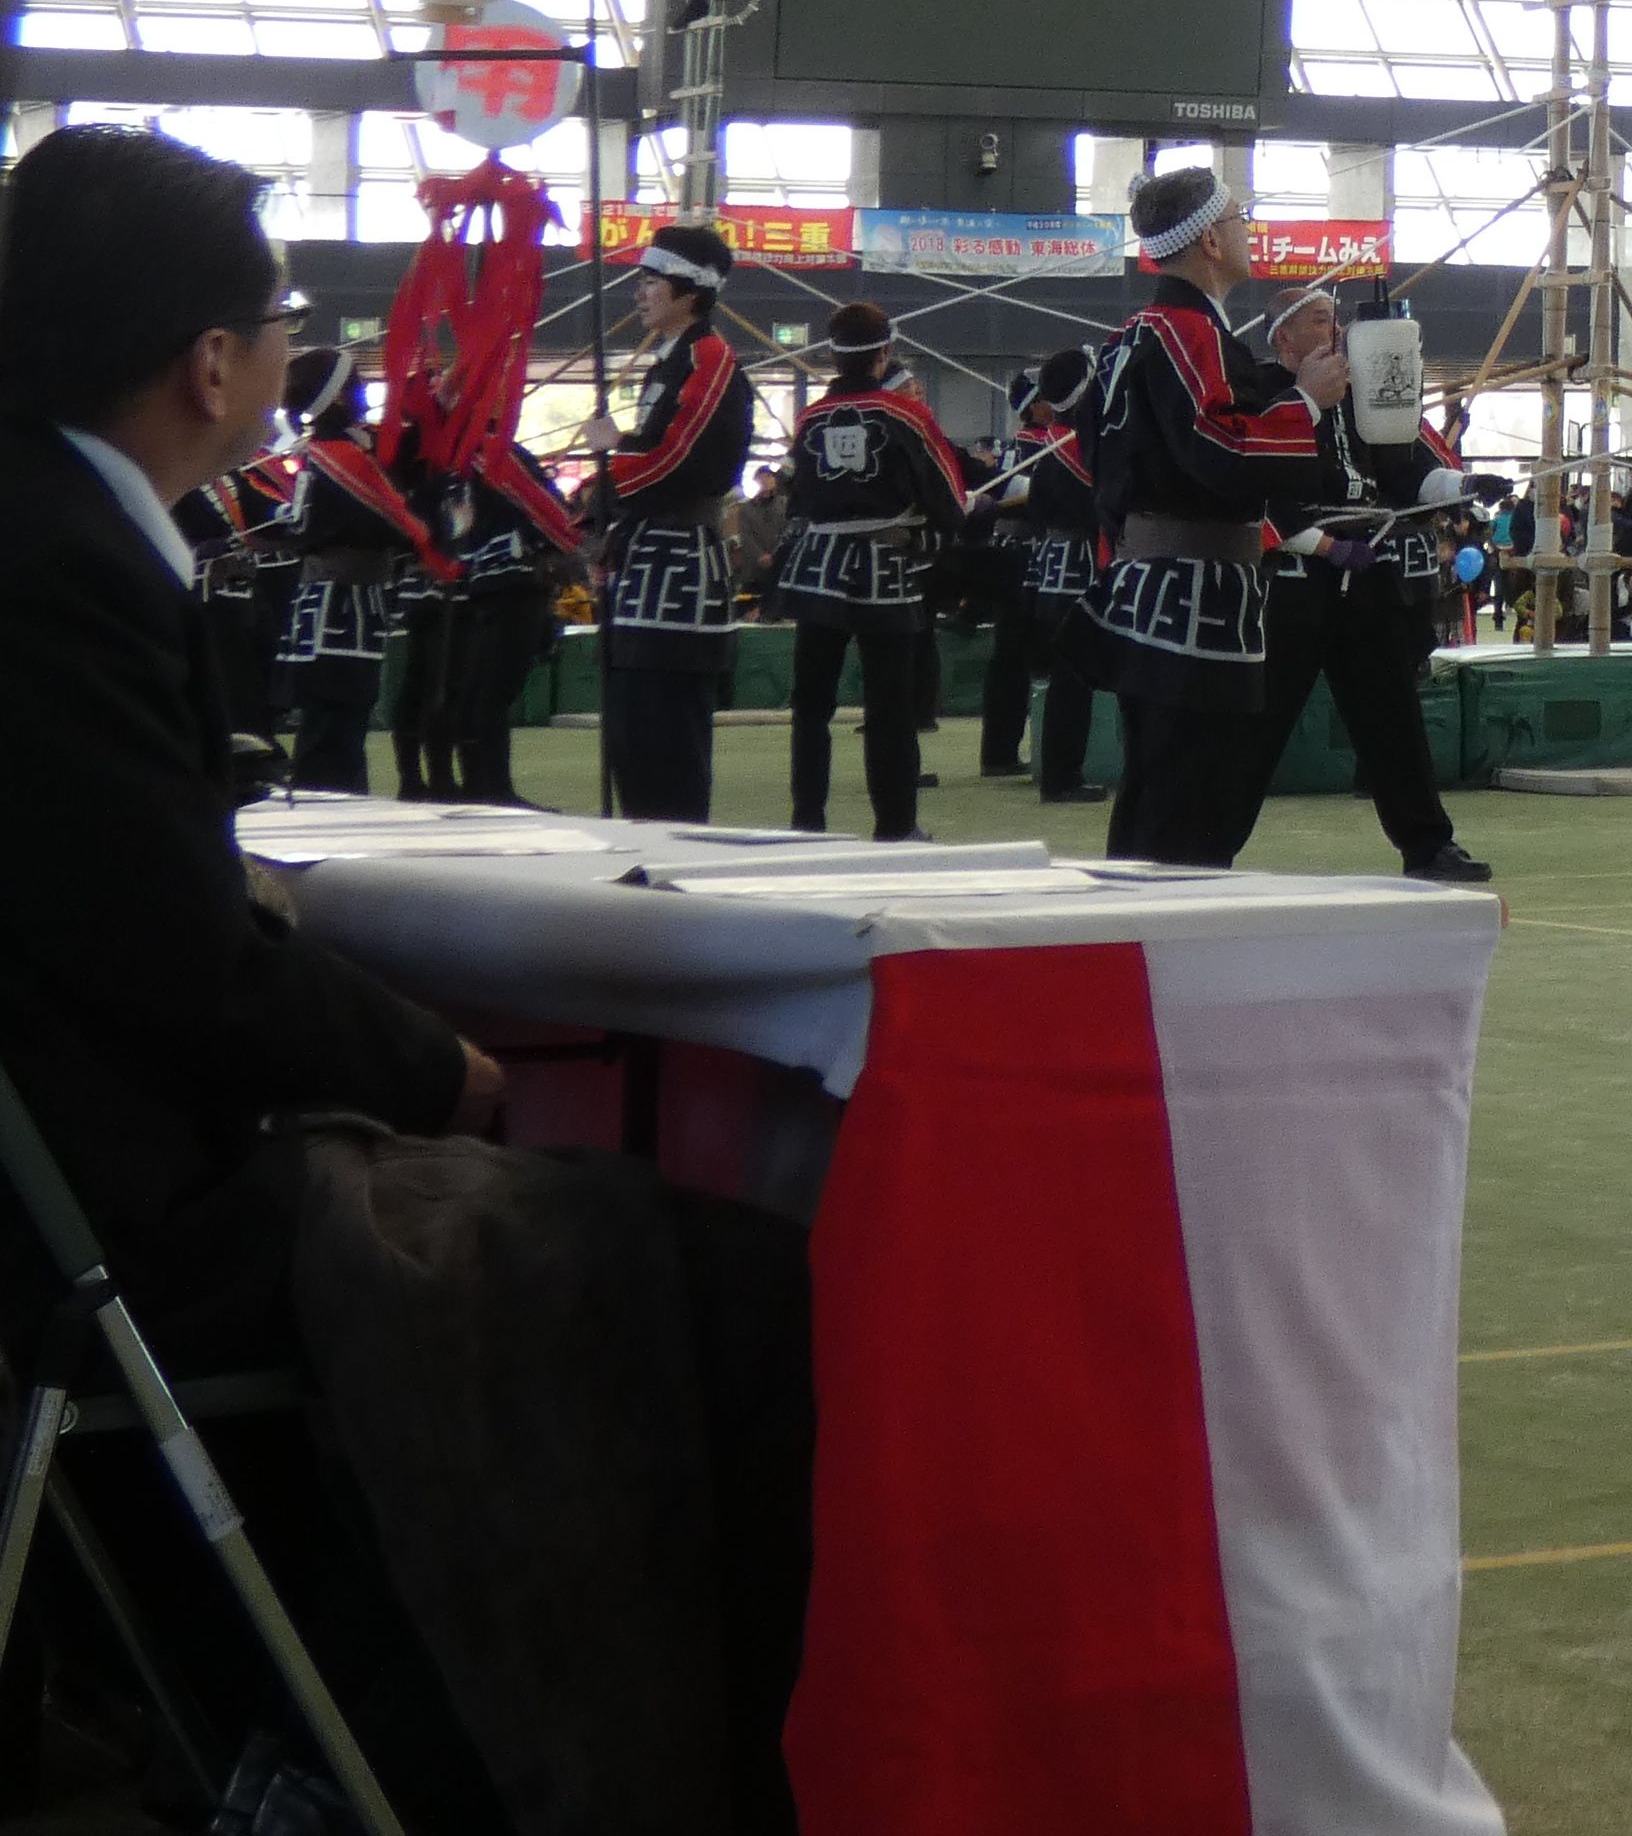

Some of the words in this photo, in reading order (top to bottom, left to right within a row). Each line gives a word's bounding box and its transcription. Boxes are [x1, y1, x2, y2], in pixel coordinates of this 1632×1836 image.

[1173, 102, 1257, 120] TOSHIBA
[600, 216, 832, 254] がんれ!三重
[910, 236, 945, 253] 2018
[952, 236, 1022, 256] 彩る感動
[1030, 238, 1097, 257] 東海総体
